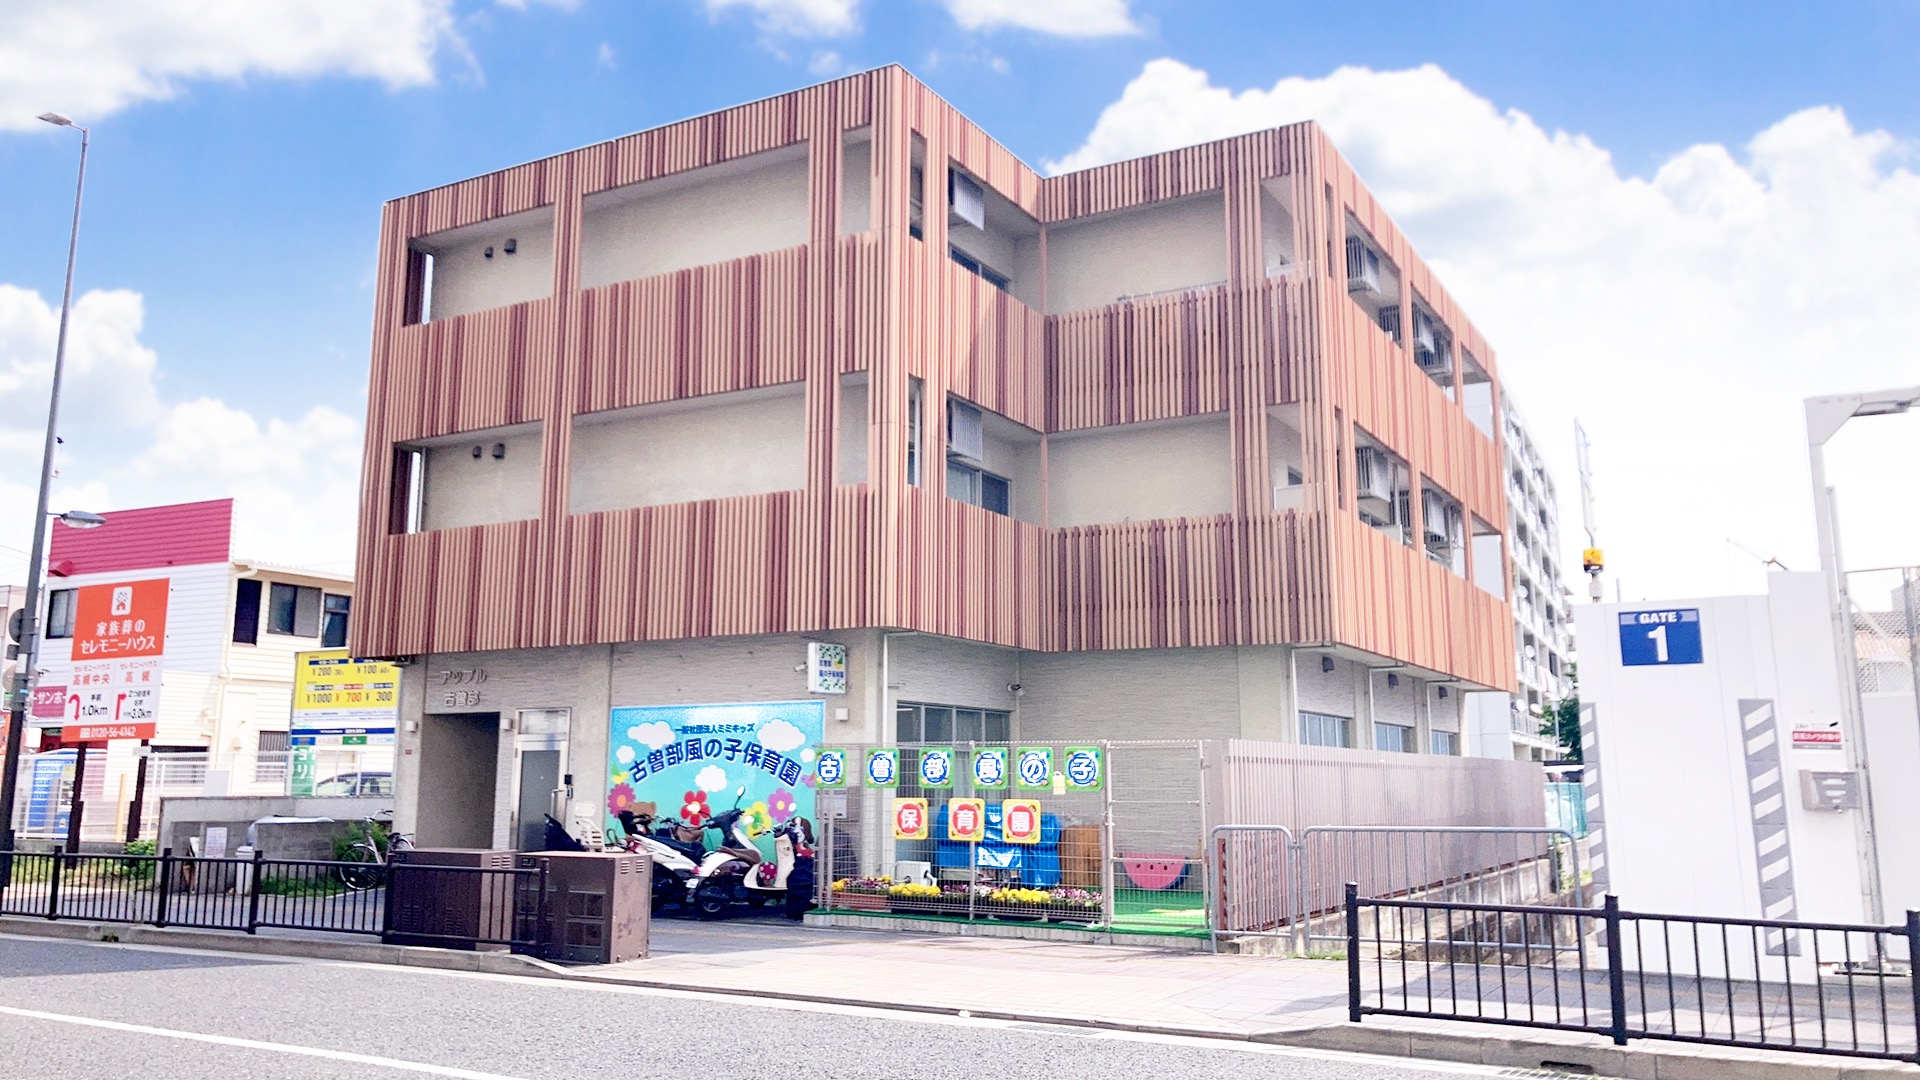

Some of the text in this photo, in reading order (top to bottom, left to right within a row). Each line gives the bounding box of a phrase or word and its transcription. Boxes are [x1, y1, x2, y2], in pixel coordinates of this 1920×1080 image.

[1640, 611, 1678, 624] GATE
[96, 619, 146, 637] 家族葬の
[80, 635, 156, 654] セレモニーハウス
[1648, 625, 1669, 662] 1
[440, 668, 488, 685] アップル
[82, 705, 108, 716] 1.0km
[675, 722, 756, 735] 一般社団法人ミミキッズ
[629, 737, 804, 788] 古曽部風の子保育園
